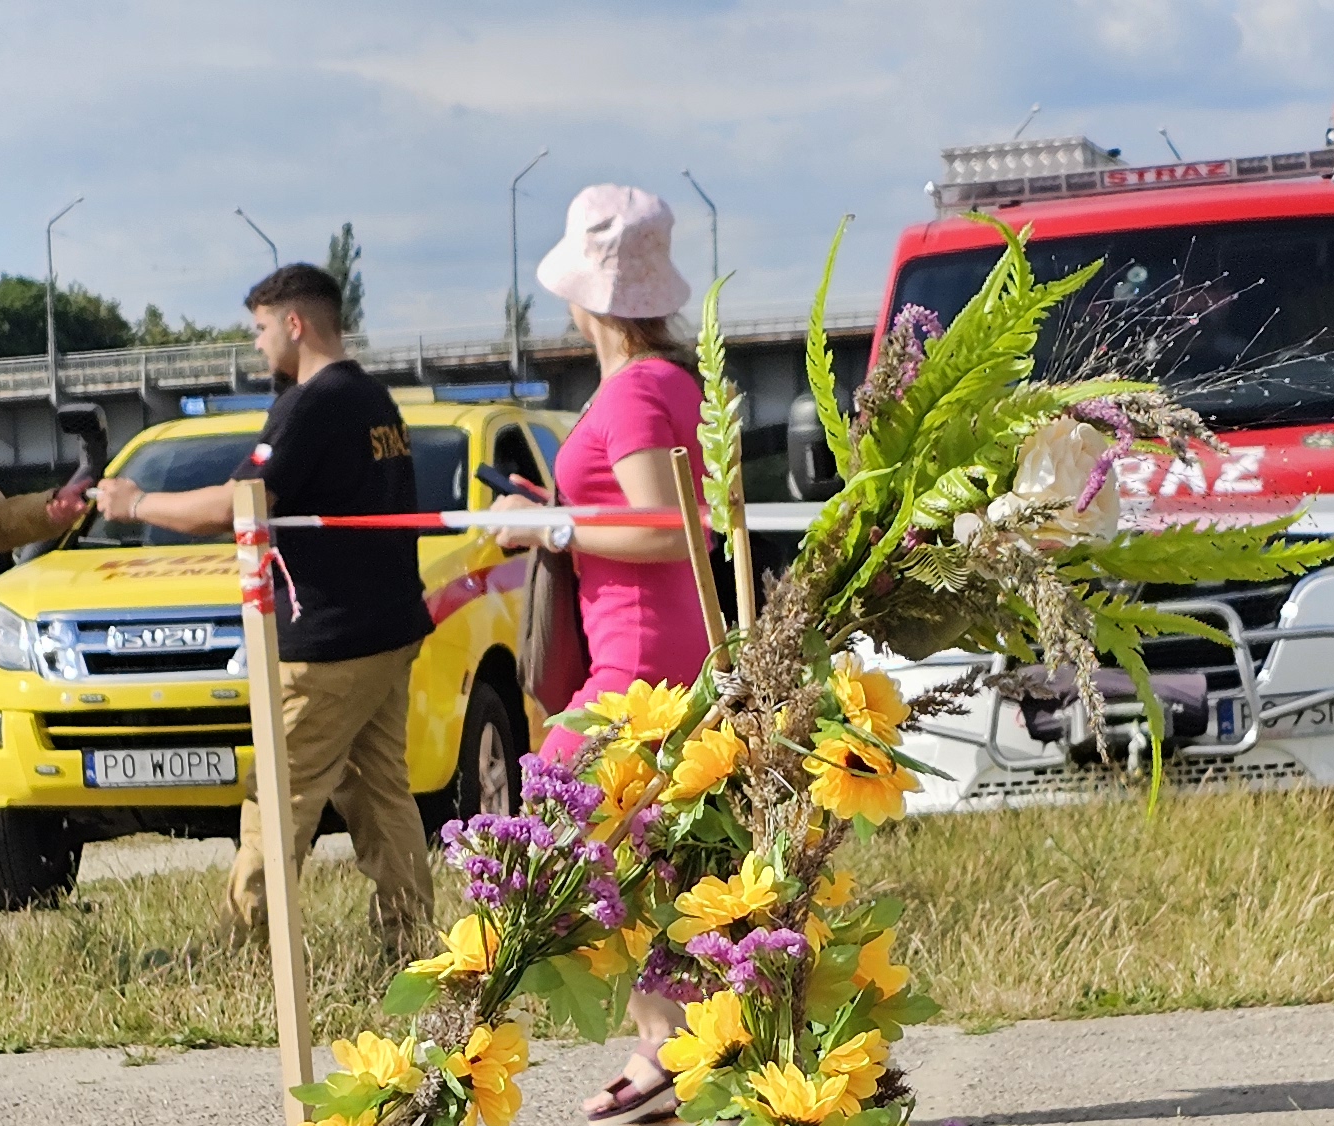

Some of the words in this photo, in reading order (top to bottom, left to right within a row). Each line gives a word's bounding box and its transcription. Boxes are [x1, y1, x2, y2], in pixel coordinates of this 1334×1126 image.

[1114, 445, 1266, 498] RAZ
[113, 628, 206, 649] ISUZU
[103, 753, 136, 779] PO
[150, 751, 222, 779] WOPR
